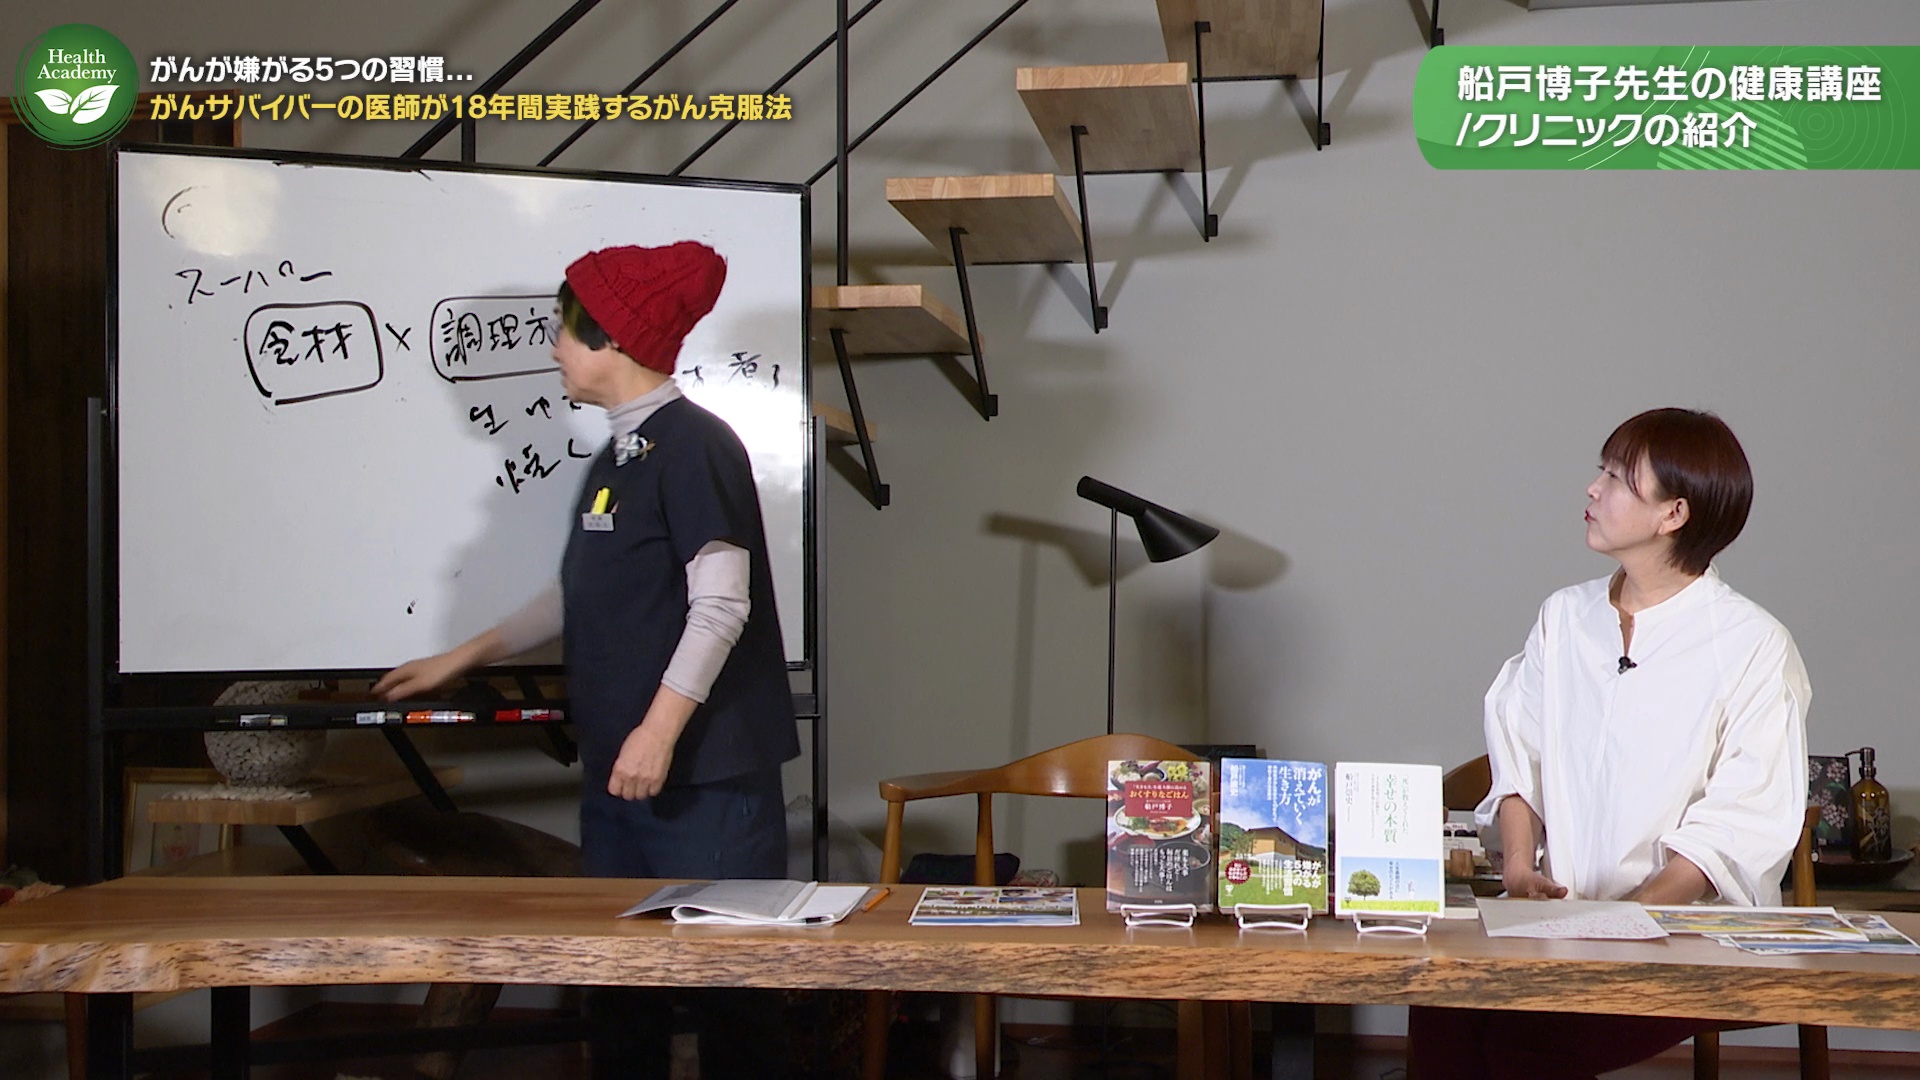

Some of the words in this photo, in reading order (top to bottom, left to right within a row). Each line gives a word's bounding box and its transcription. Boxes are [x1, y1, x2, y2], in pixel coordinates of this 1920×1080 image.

[1129, 790, 1189, 799] おくすりなごはん
[1279, 765, 1293, 806] 生き方
[1293, 766, 1307, 826] 消えていく
[1307, 767, 1323, 807] がんが
[1384, 773, 1398, 844] 幸せの本質
